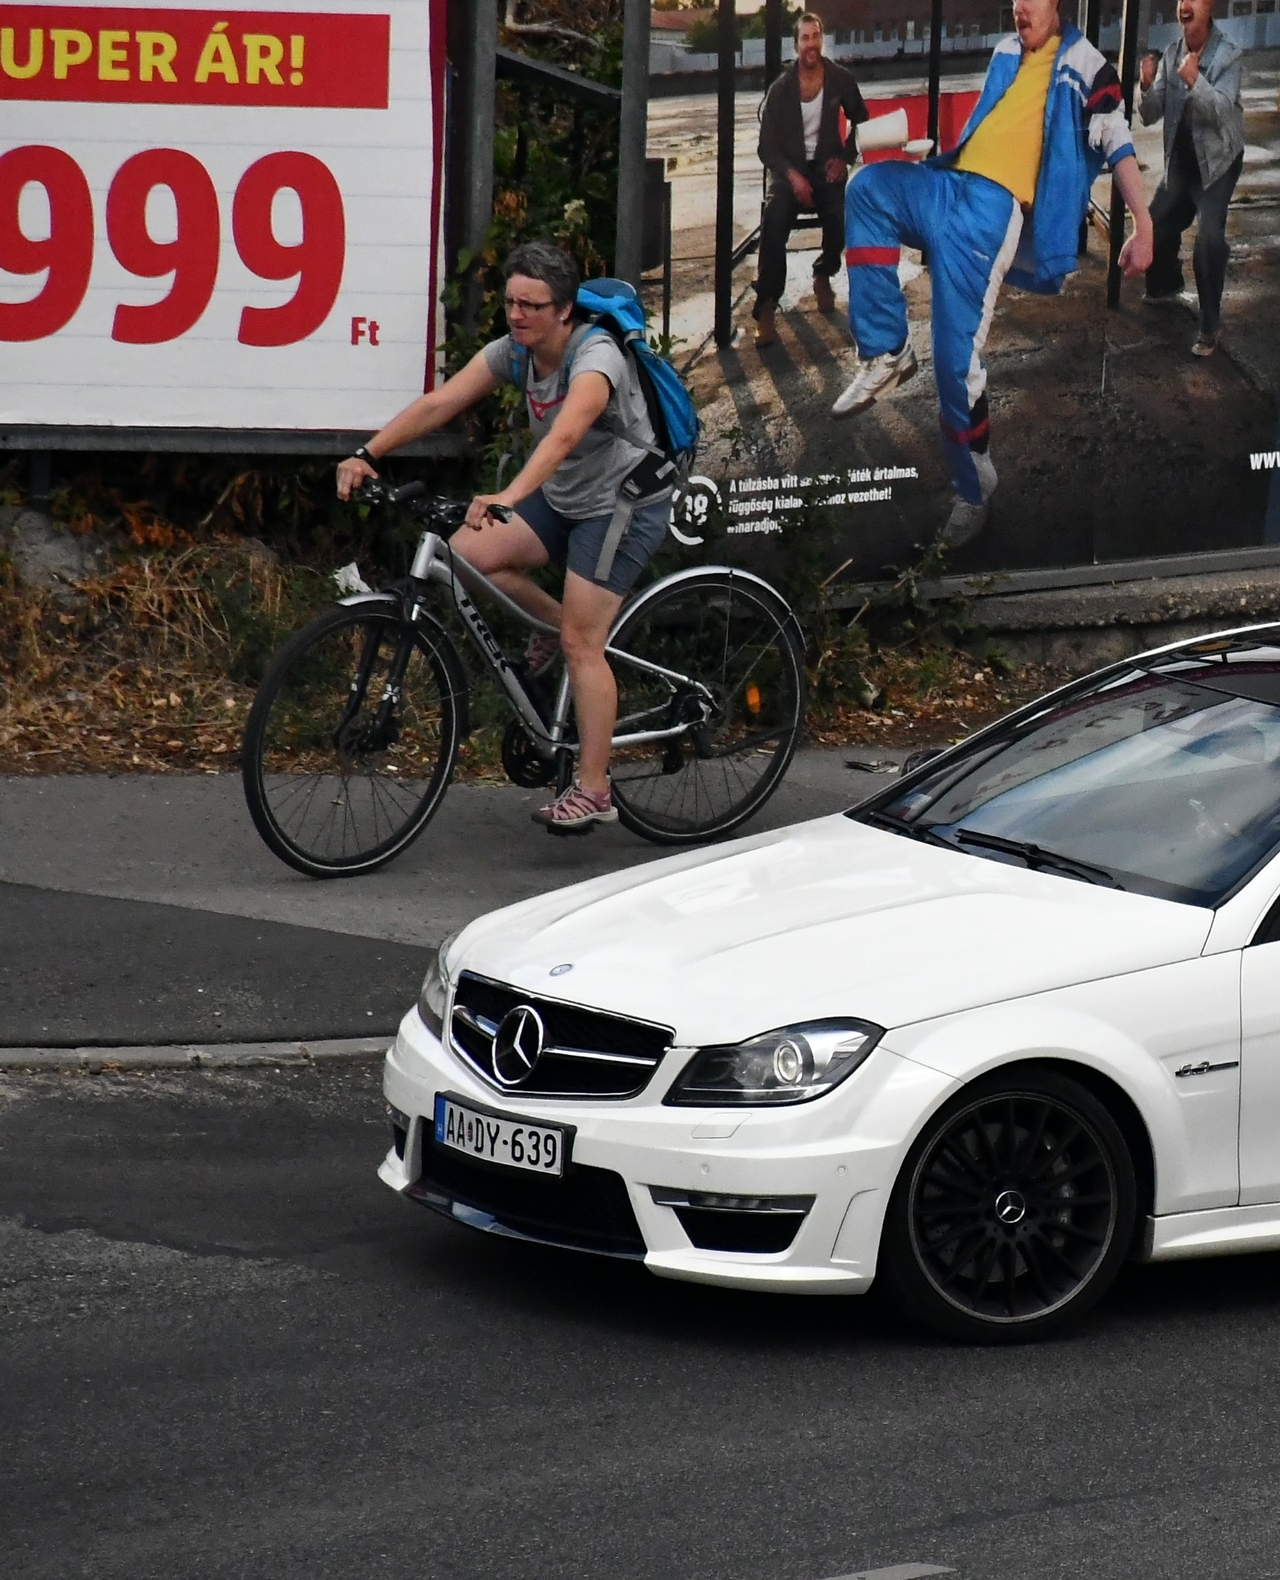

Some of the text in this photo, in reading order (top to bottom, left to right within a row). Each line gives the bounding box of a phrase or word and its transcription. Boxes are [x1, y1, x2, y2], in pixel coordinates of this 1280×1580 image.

[195, 21, 305, 86] ÁR!
[350, 316, 380, 347] Ft
[729, 479, 737, 494] A
[739, 475, 780, 493] túlzásba
[782, 474, 799, 489] vitt
[873, 465, 919, 481] ártalmas,
[848, 486, 892, 503] vezethet!
[460, 591, 512, 674] TREK
